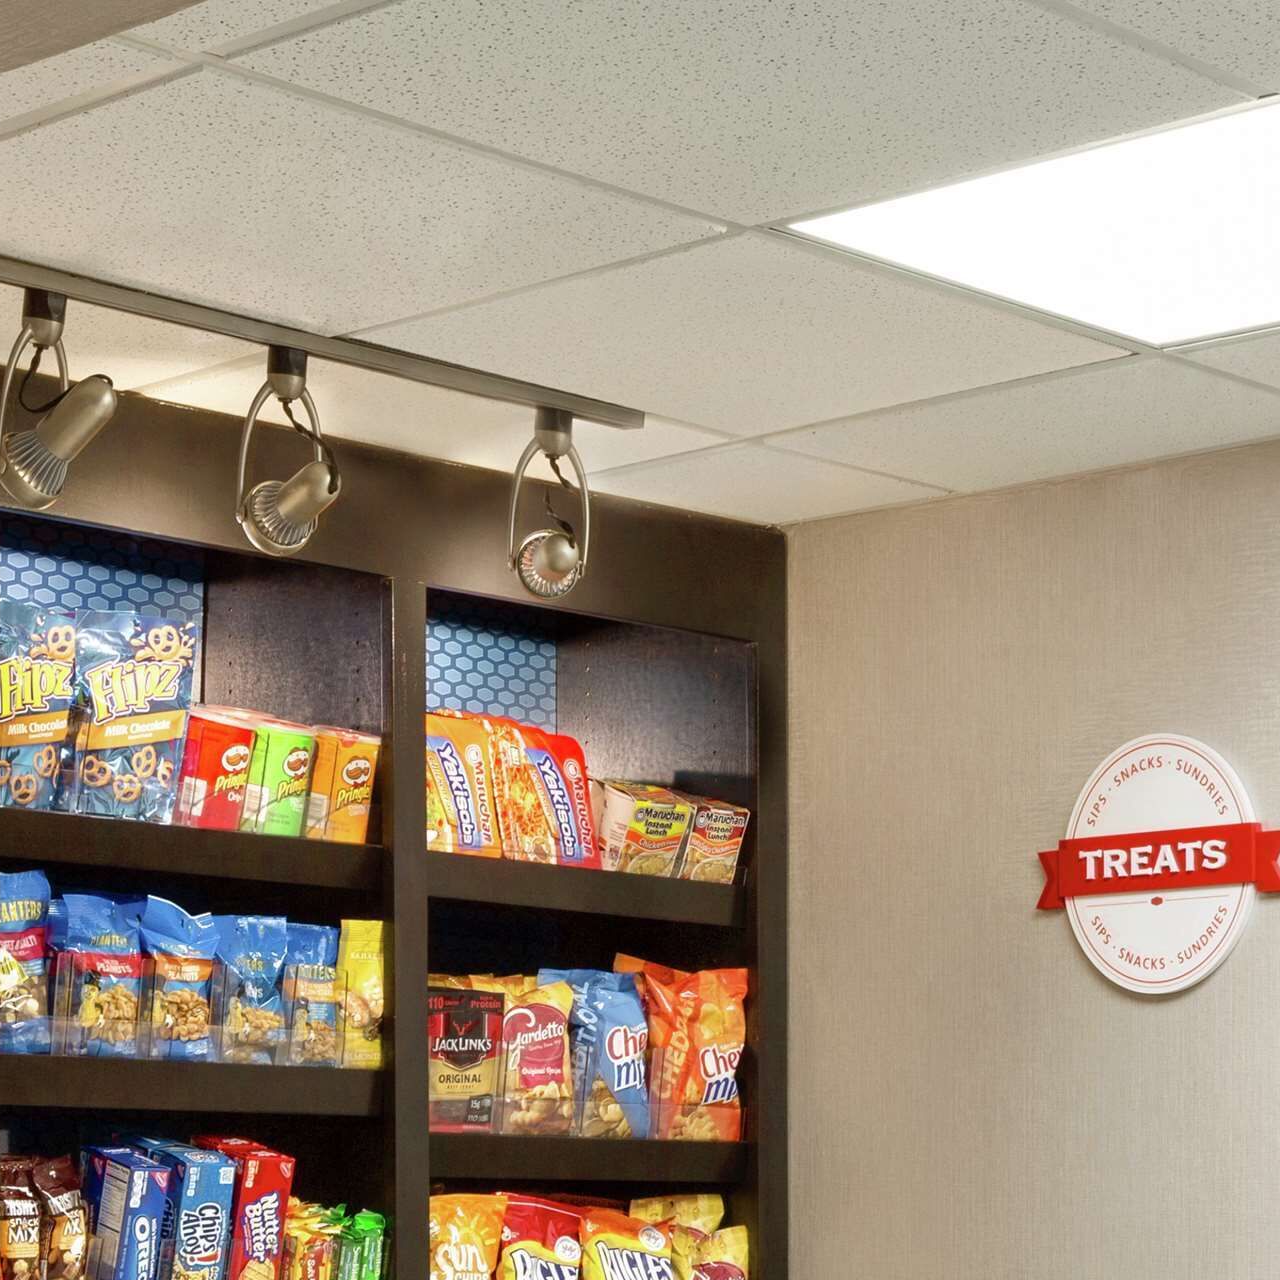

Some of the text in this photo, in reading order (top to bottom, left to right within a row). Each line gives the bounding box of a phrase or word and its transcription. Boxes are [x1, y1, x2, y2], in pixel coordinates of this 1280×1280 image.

[86, 661, 182, 725] Flipz
[436, 742, 476, 846] Yakisoba
[473, 760, 493, 844] Maruchan
[536, 755, 578, 858] Yakisoba
[574, 776, 593, 858] Maruchan
[644, 808, 686, 822] Maruchan
[705, 812, 746, 826] Maruchan
[1087, 756, 1229, 827] SIPS SNACKS SUNDRIES
[645, 827, 668, 837] Lunch
[1078, 839, 1227, 881] TREATS
[1091, 905, 1228, 970] SIPS SNACKS SUNDRIES
[606, 1025, 648, 1063] Che
[438, 1074, 482, 1084] ORIGINAL
[8, 1227, 39, 1244] MIX
[198, 1202, 221, 1254] Chips
[244, 1202, 266, 1264] Butter
[260, 1192, 281, 1256] Nutter
